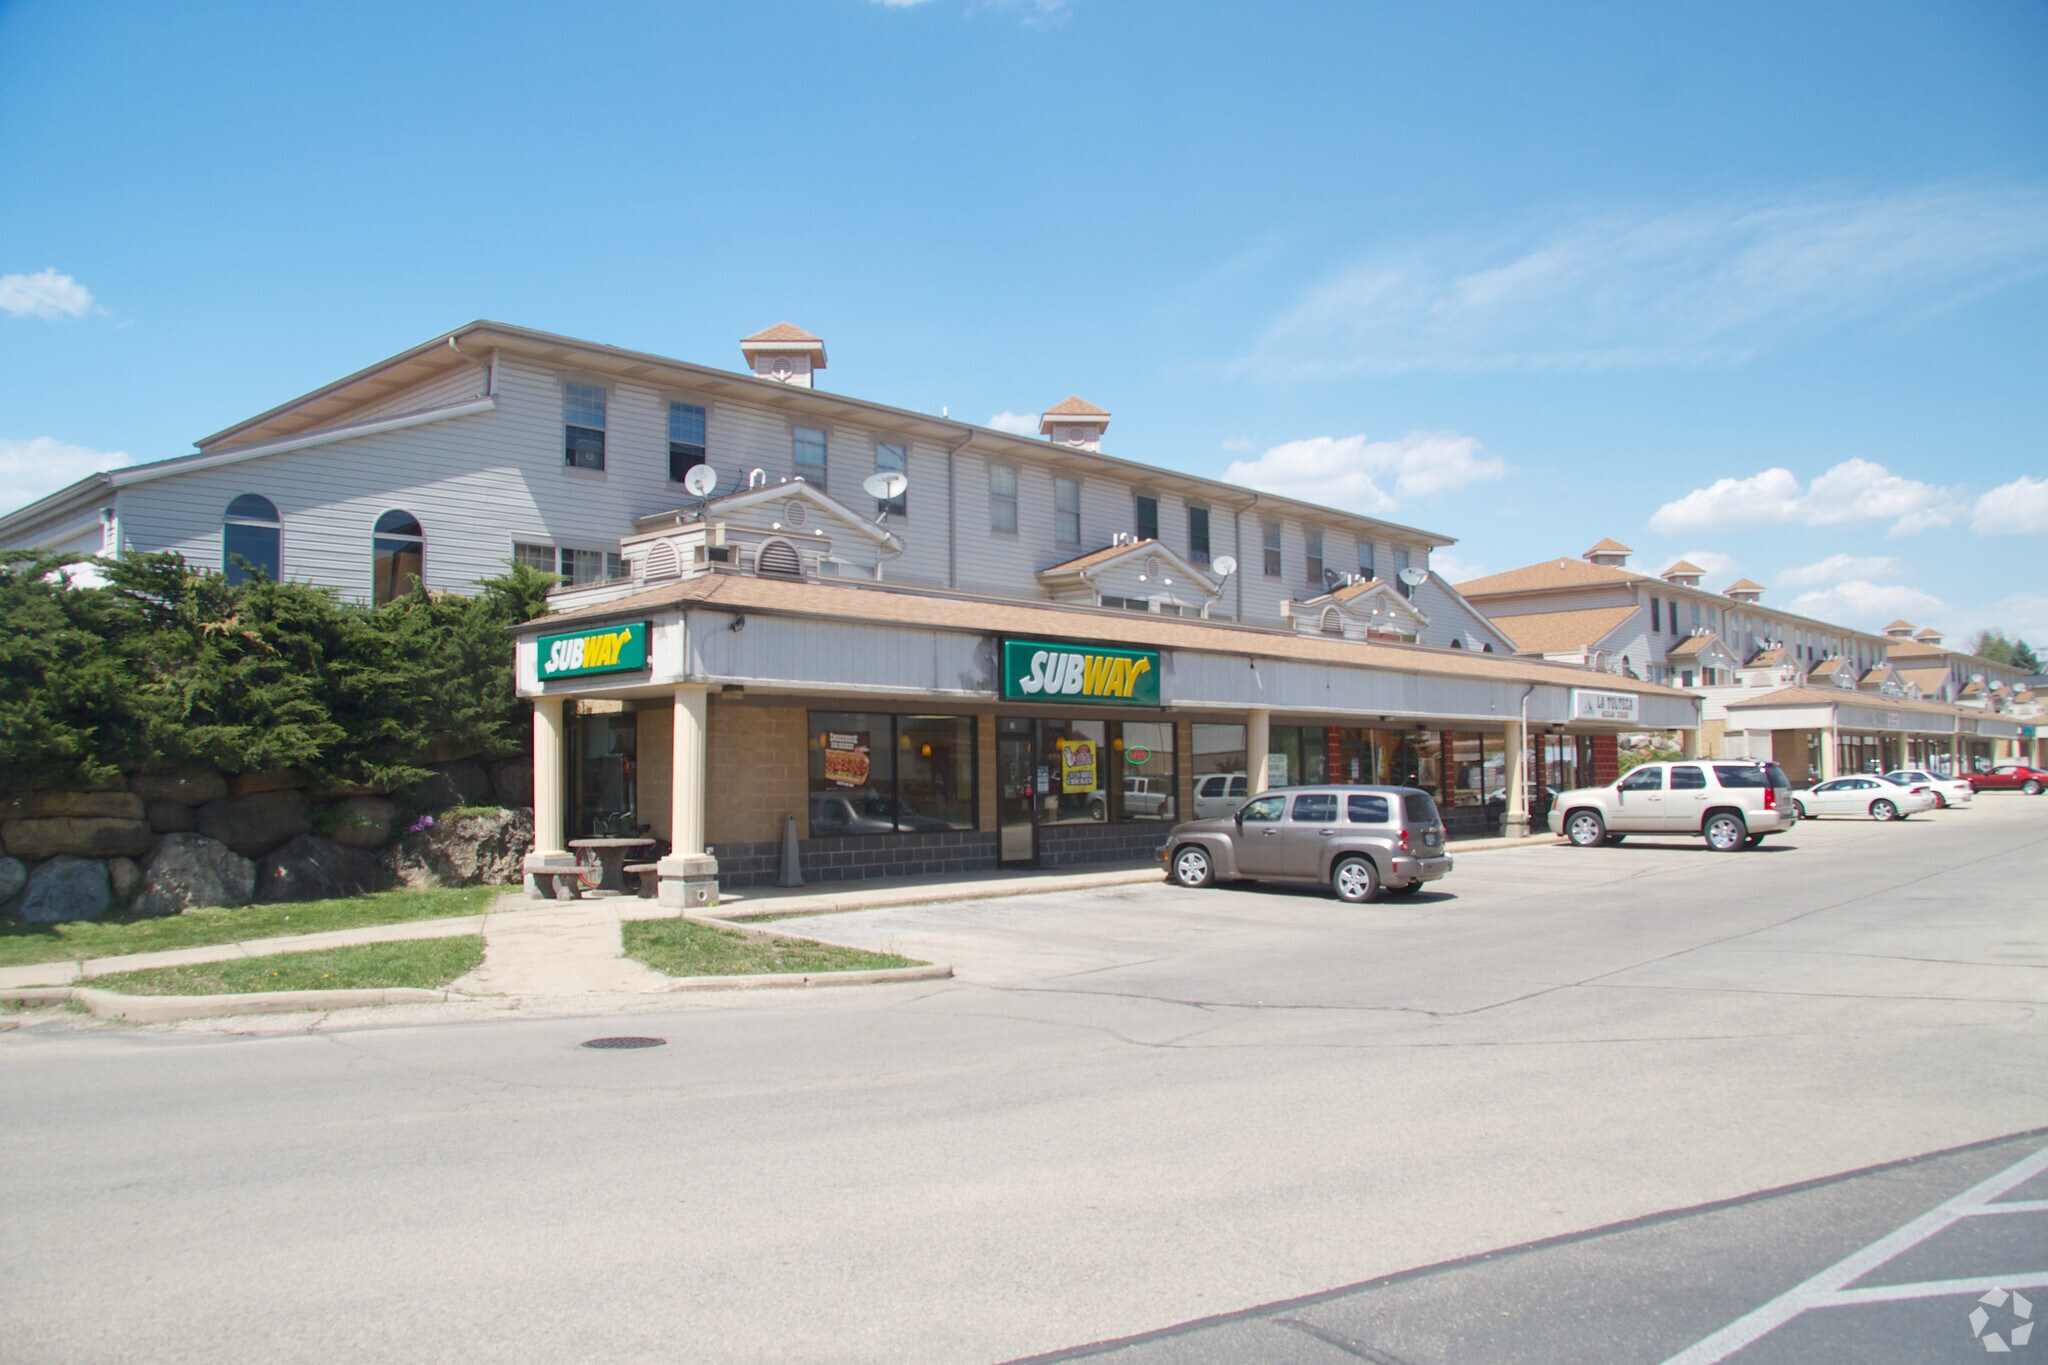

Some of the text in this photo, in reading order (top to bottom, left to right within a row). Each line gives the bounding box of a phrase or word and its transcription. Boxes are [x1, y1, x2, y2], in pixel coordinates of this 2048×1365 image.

[544, 627, 632, 674] SUBWAY
[1019, 650, 1151, 697] SUBWAY
[1597, 696, 1632, 710] LA TOLTECA
